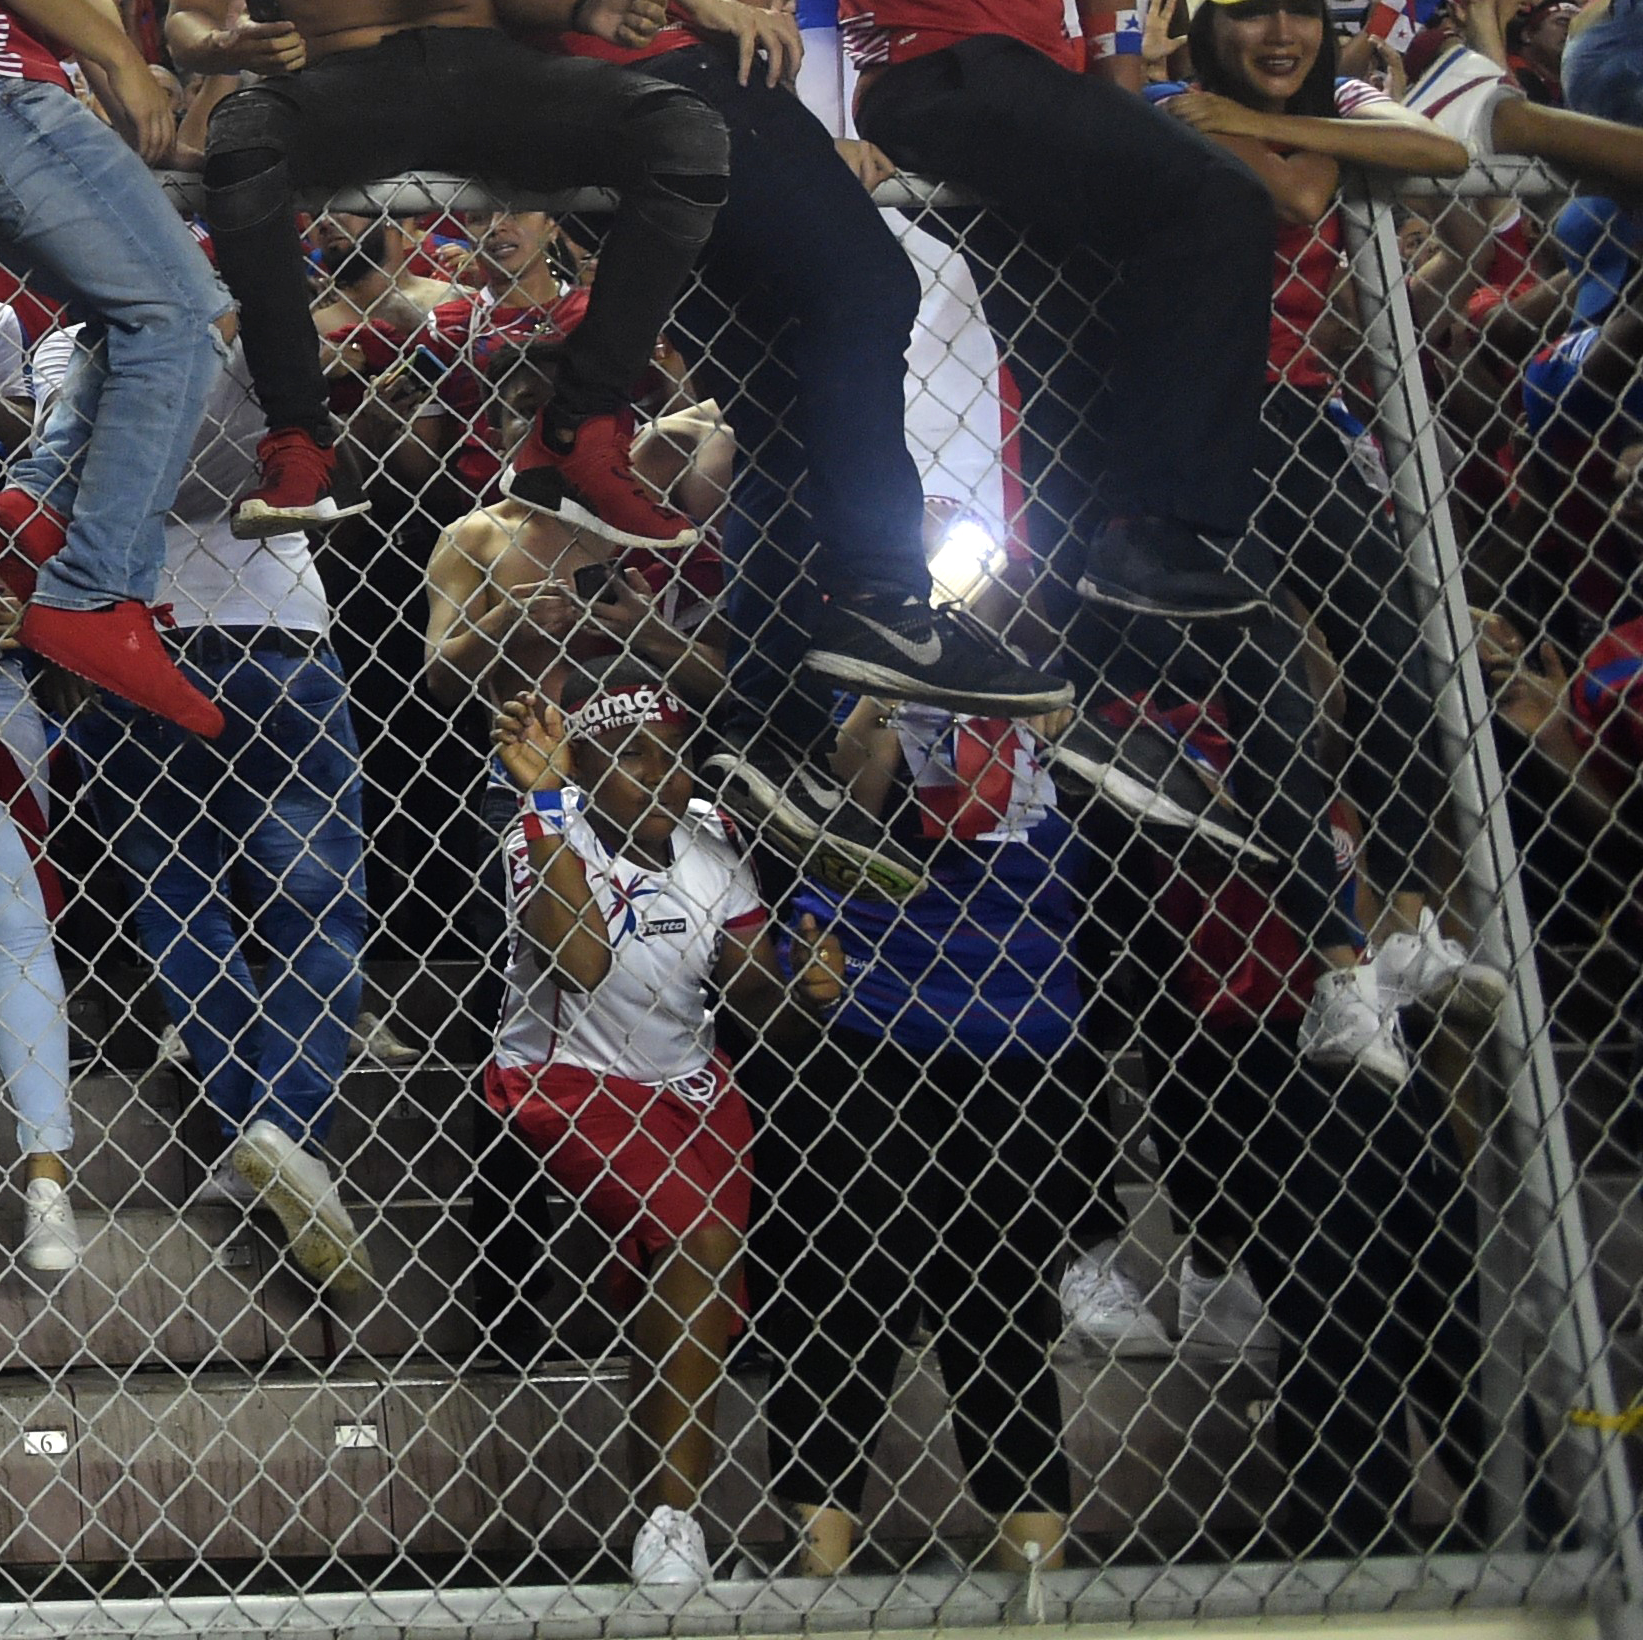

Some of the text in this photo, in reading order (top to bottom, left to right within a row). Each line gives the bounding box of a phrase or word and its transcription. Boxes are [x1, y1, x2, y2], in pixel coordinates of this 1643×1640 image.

[602, 711, 663, 731] Titaes
[226, 1247, 237, 1264] 7
[40, 1433, 53, 1454] 6
